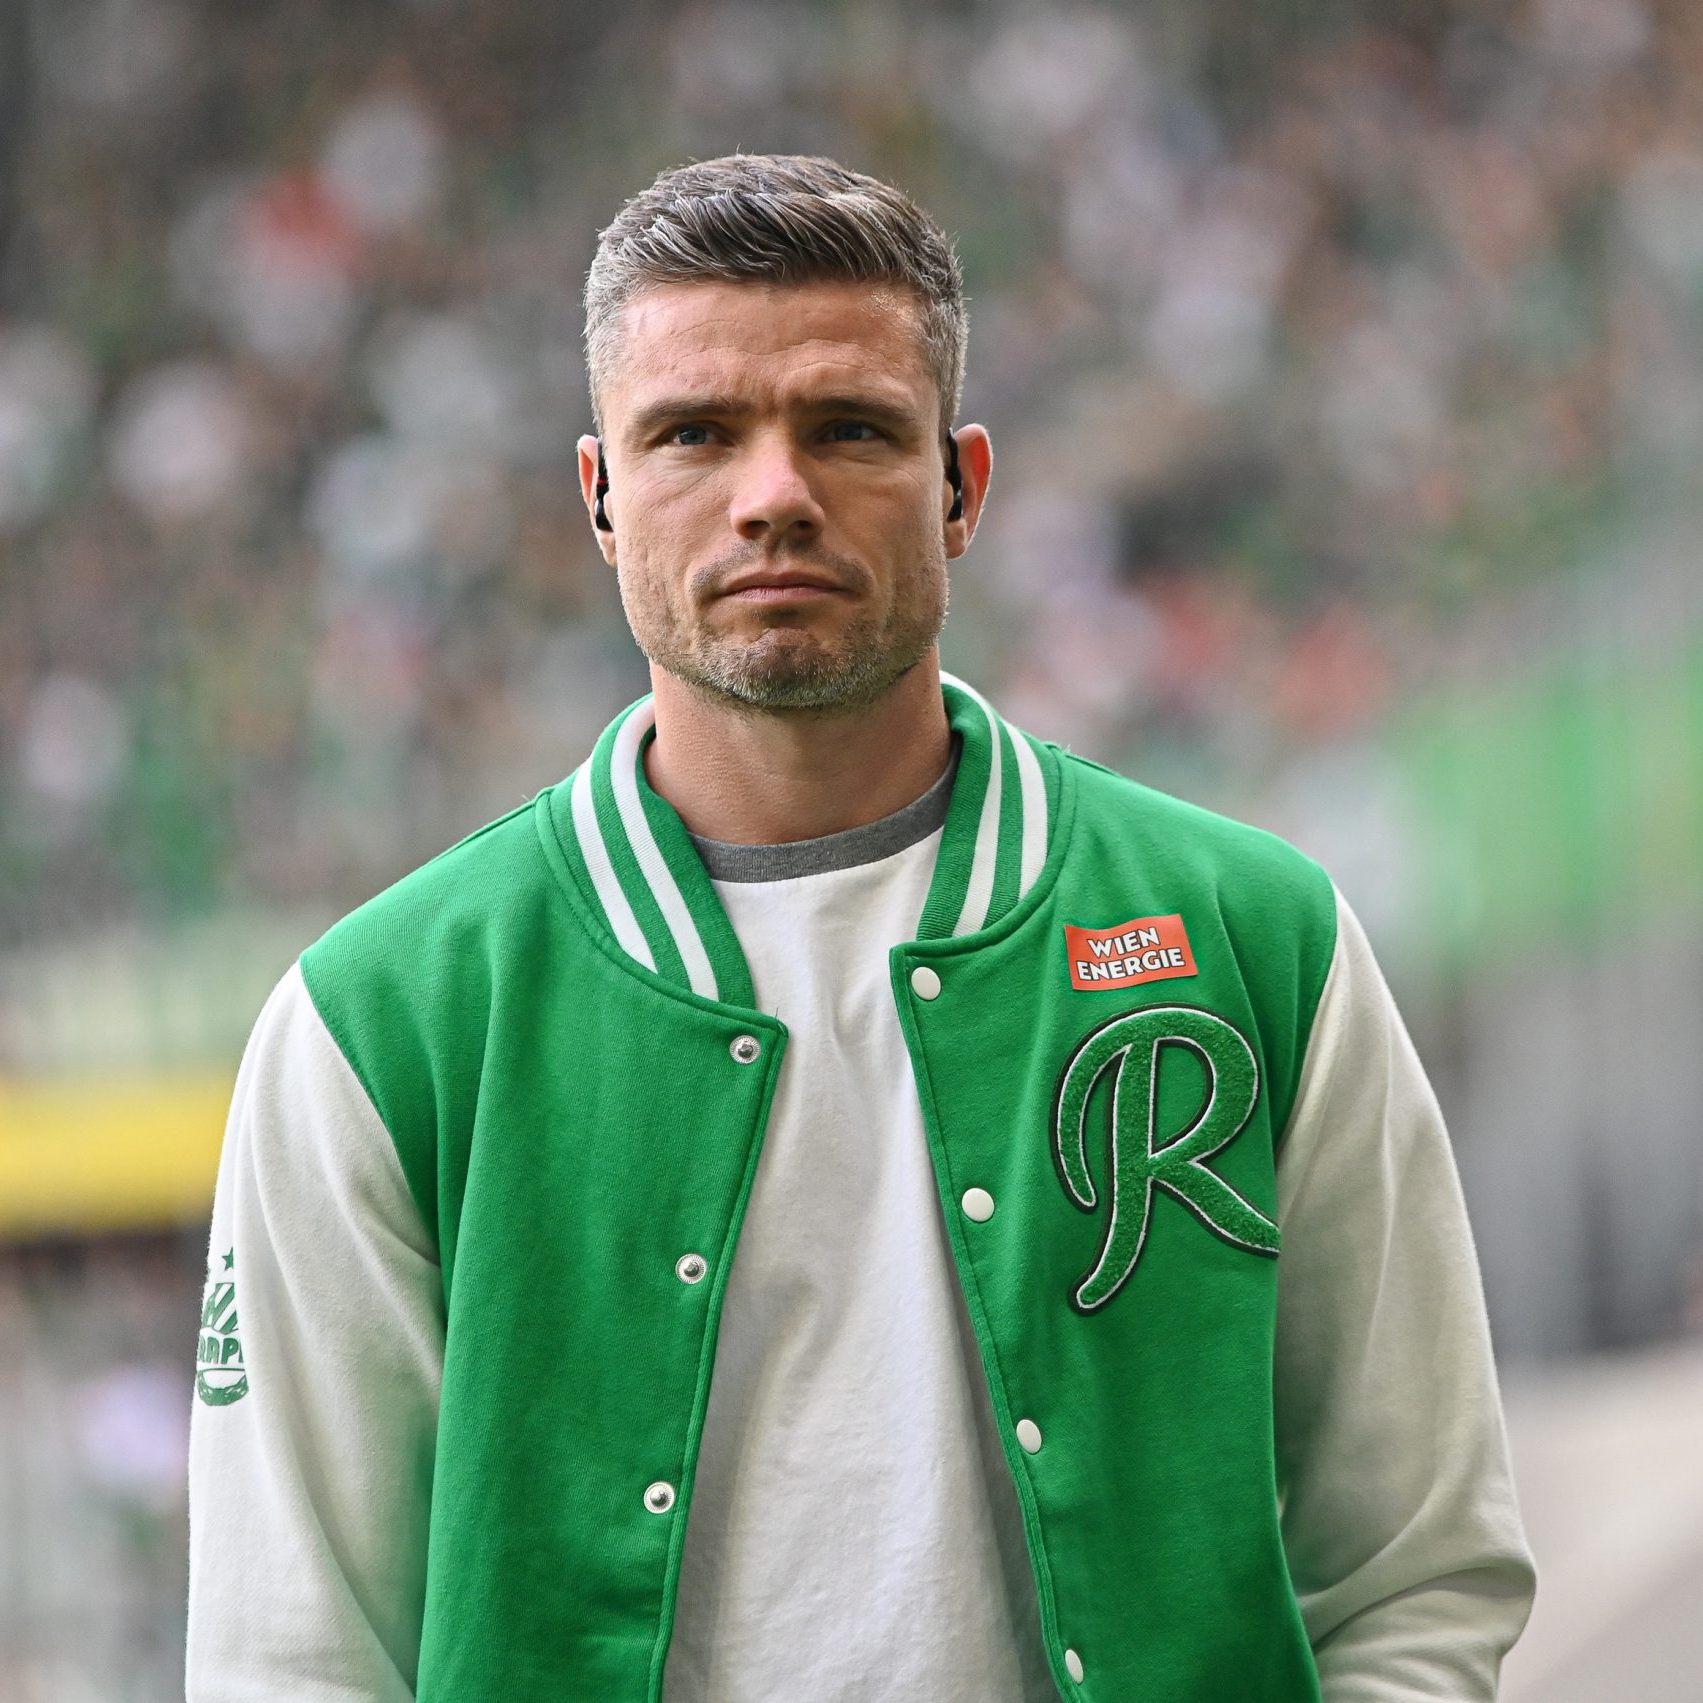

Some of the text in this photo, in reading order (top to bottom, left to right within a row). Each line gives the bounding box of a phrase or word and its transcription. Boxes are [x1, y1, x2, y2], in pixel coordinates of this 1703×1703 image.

[1087, 927, 1161, 958] WIEN
[1076, 947, 1185, 981] ENERGIE
[1052, 1003, 1281, 1313] R
